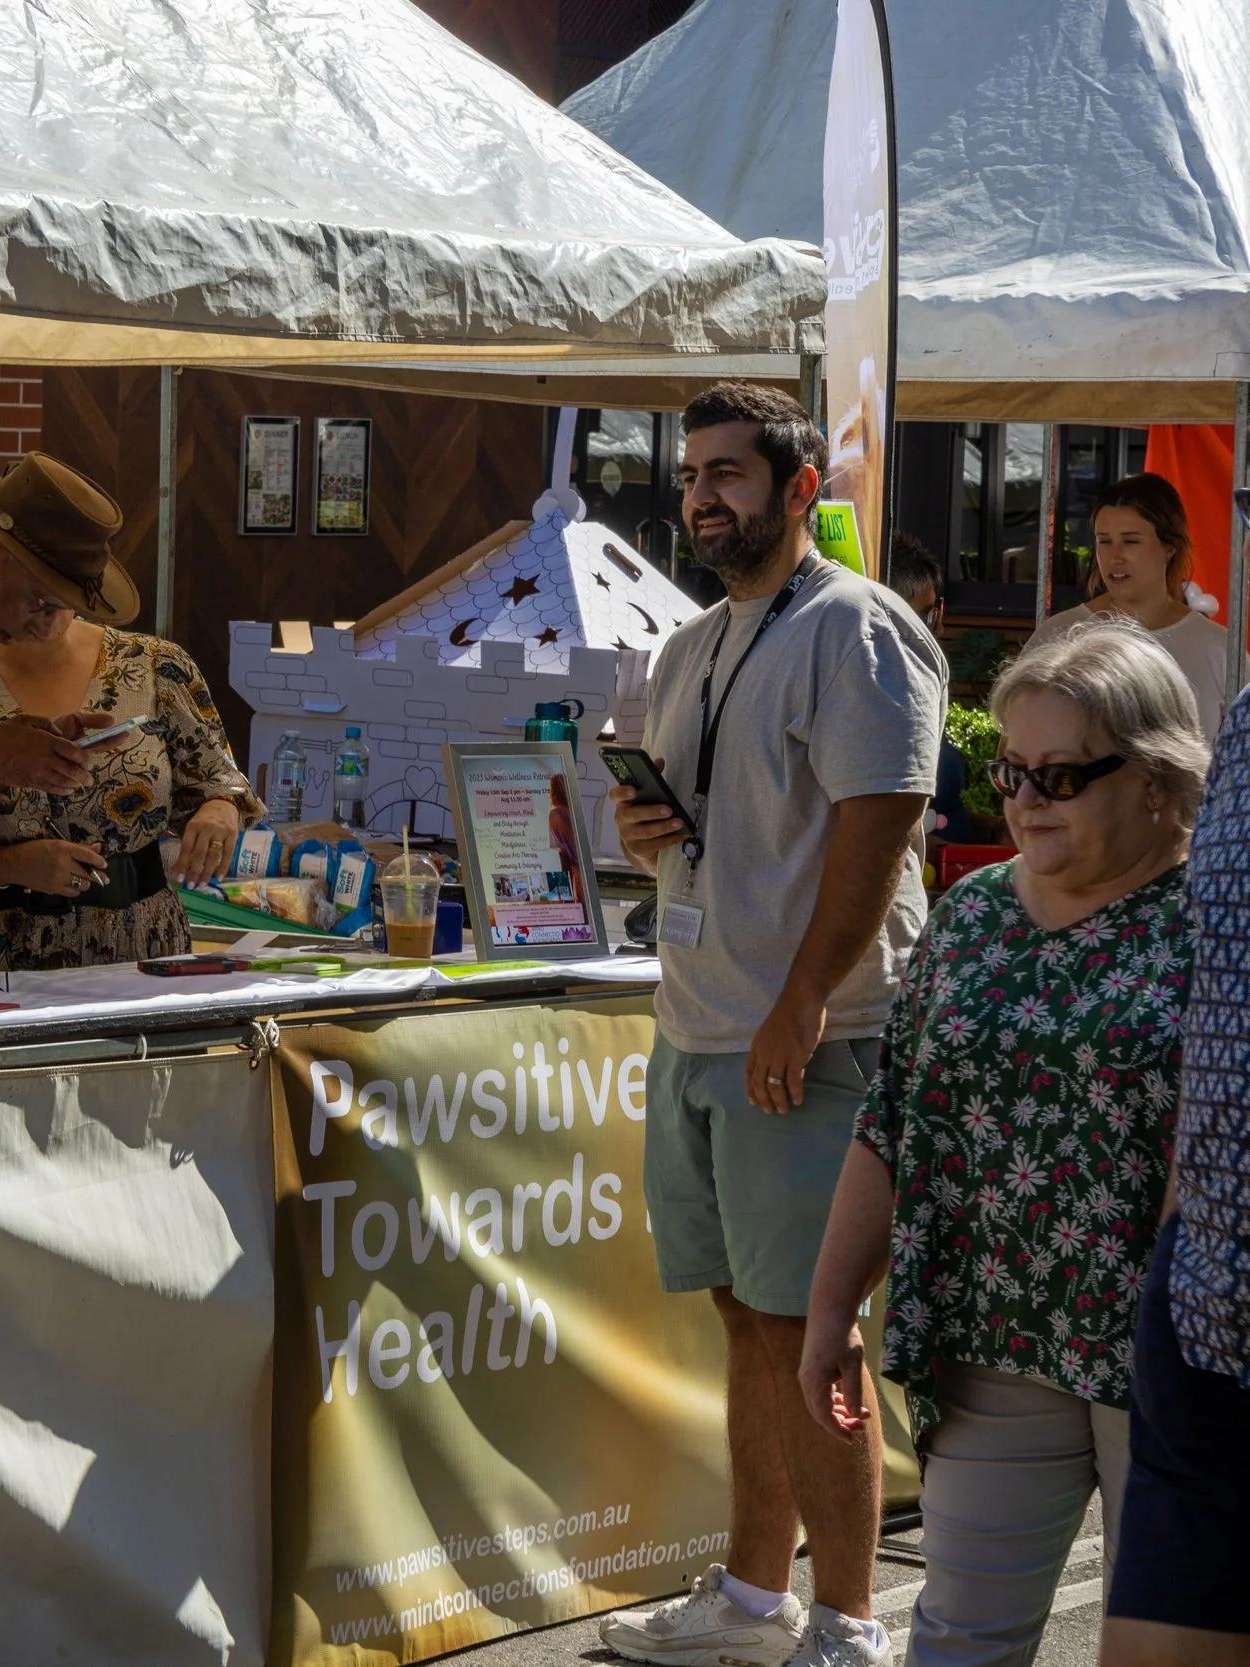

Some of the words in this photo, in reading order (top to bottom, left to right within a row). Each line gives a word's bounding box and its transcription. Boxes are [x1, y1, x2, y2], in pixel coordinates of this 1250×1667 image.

[826, 513, 846, 541] LIST
[249, 852, 258, 874] WHITE
[345, 872, 354, 894] WHITE
[308, 1037, 648, 1156] Pawsitive
[303, 1152, 623, 1278] Towards
[315, 1276, 557, 1405] Health
[335, 1503, 631, 1593] www.pawsitivesteps.com.au
